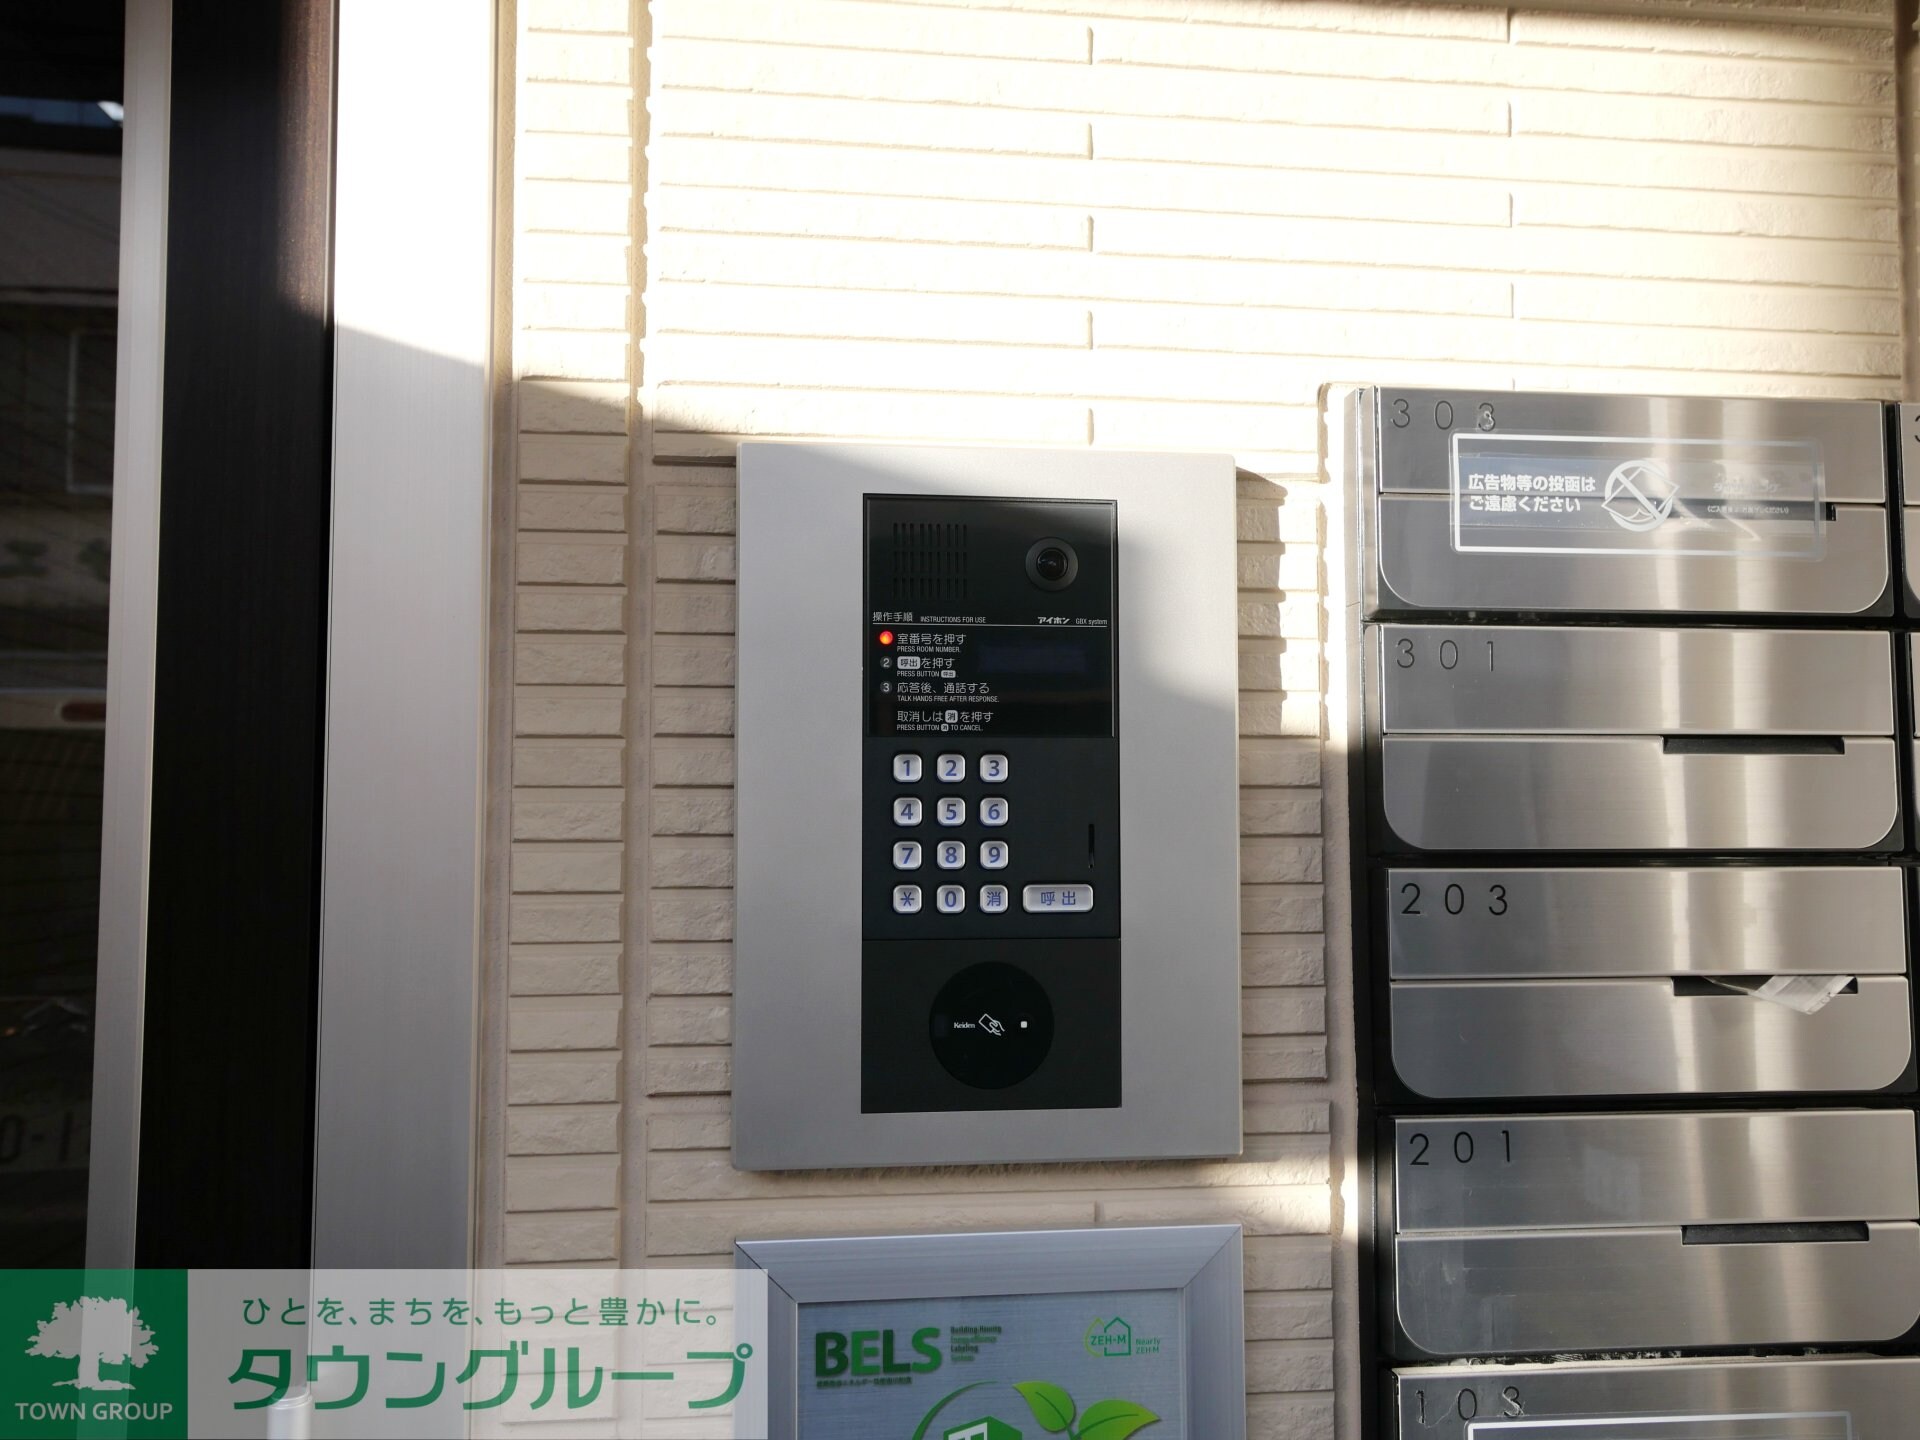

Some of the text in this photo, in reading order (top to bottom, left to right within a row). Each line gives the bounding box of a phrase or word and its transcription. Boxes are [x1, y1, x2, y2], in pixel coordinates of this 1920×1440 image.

[1468, 473, 1596, 492] 広告物等の投函は
[1469, 495, 1581, 512] ご遠慮ください
[873, 611, 913, 622] 操作手順
[974, 616, 986, 624] USE
[1037, 616, 1071, 625] アイホン
[1088, 618, 1108, 627] system
[897, 633, 967, 645] 室番号を押す
[1396, 638, 1495, 673] 301
[897, 682, 990, 694] 応答後、通話する
[902, 759, 911, 777] 1
[945, 760, 957, 777] 2
[988, 760, 1000, 777] 3
[900, 803, 914, 820] 4
[946, 804, 957, 820] 5
[988, 804, 1001, 820] 6
[902, 847, 914, 864] 7
[945, 847, 957, 864] 8
[988, 847, 1001, 864] 9
[944, 891, 957, 908] 0
[986, 891, 1001, 907] 消
[1401, 882, 1509, 916] 203
[953, 1021, 976, 1029] Keiden
[1409, 1129, 1513, 1167] 201
[1090, 1335, 1126, 1345] ZEH-M
[1135, 1338, 1160, 1346] Nearly
[815, 1326, 943, 1378] BELS
